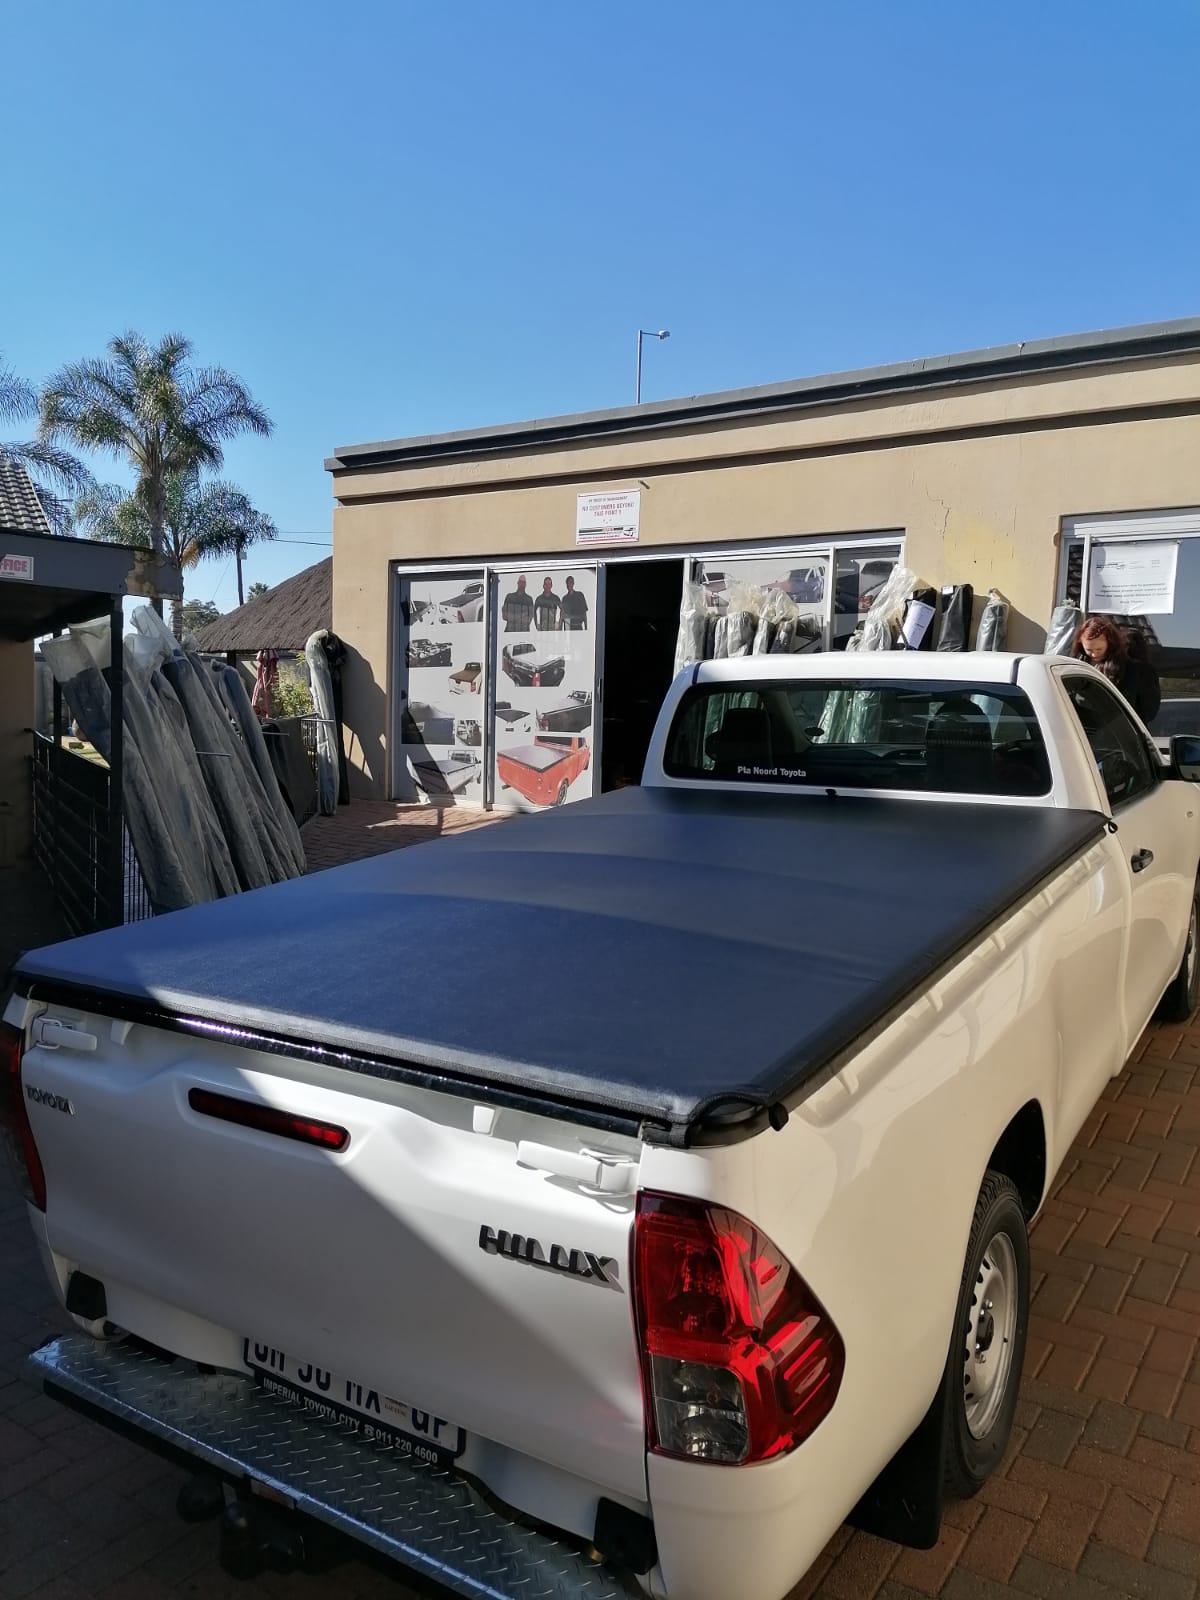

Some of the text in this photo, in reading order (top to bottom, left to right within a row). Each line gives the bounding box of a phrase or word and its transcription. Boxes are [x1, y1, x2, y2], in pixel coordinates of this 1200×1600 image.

[753, 766, 778, 775] Noord
[780, 768, 807, 778] Toyota
[25, 1084, 75, 1116] TOYOTA
[479, 1224, 620, 1285] HILUX
[263, 1377, 438, 1463] IMPERIAL TOYOTA CITY 011 220 4600
